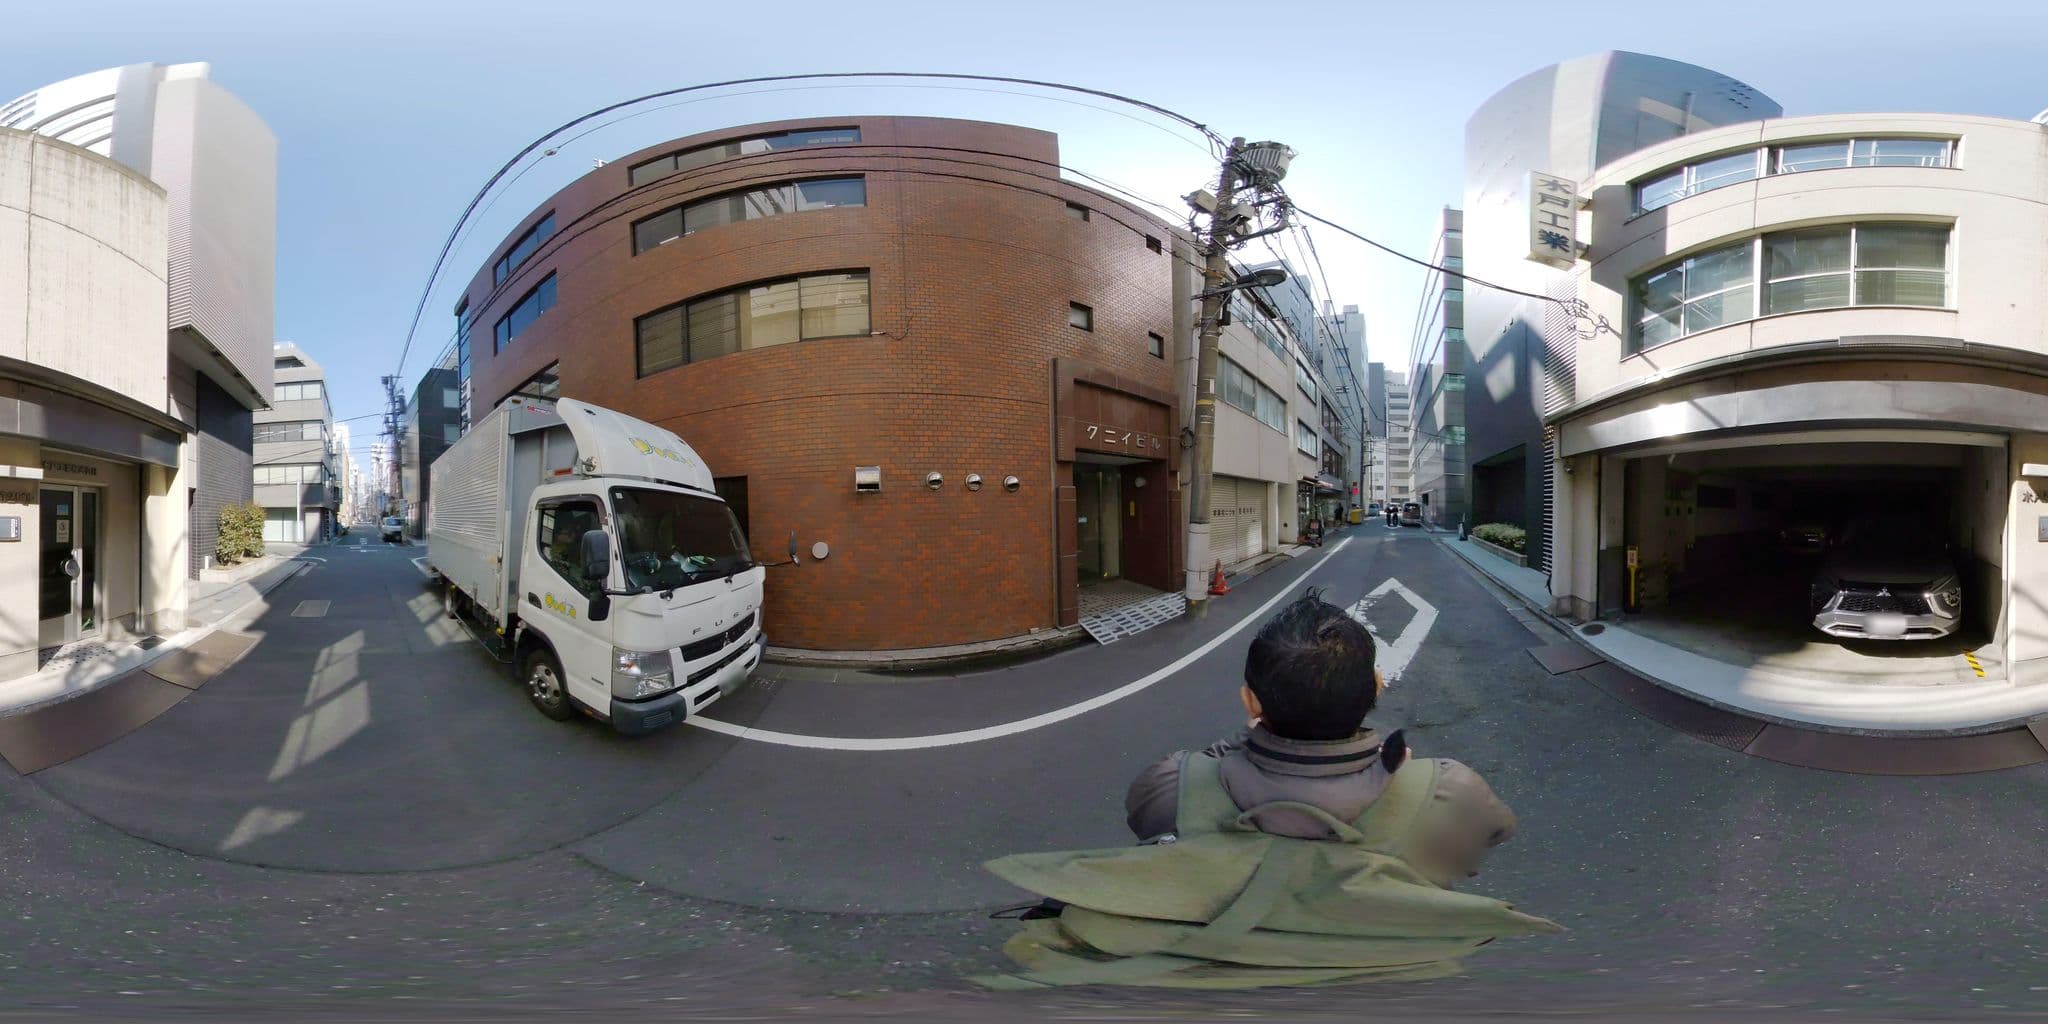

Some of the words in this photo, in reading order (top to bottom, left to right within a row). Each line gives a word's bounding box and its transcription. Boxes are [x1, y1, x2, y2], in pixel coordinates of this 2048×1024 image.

[1536, 178, 1572, 253] 水戸工業
[1087, 425, 1161, 449] クニイビル
[692, 604, 752, 635] FUSO
